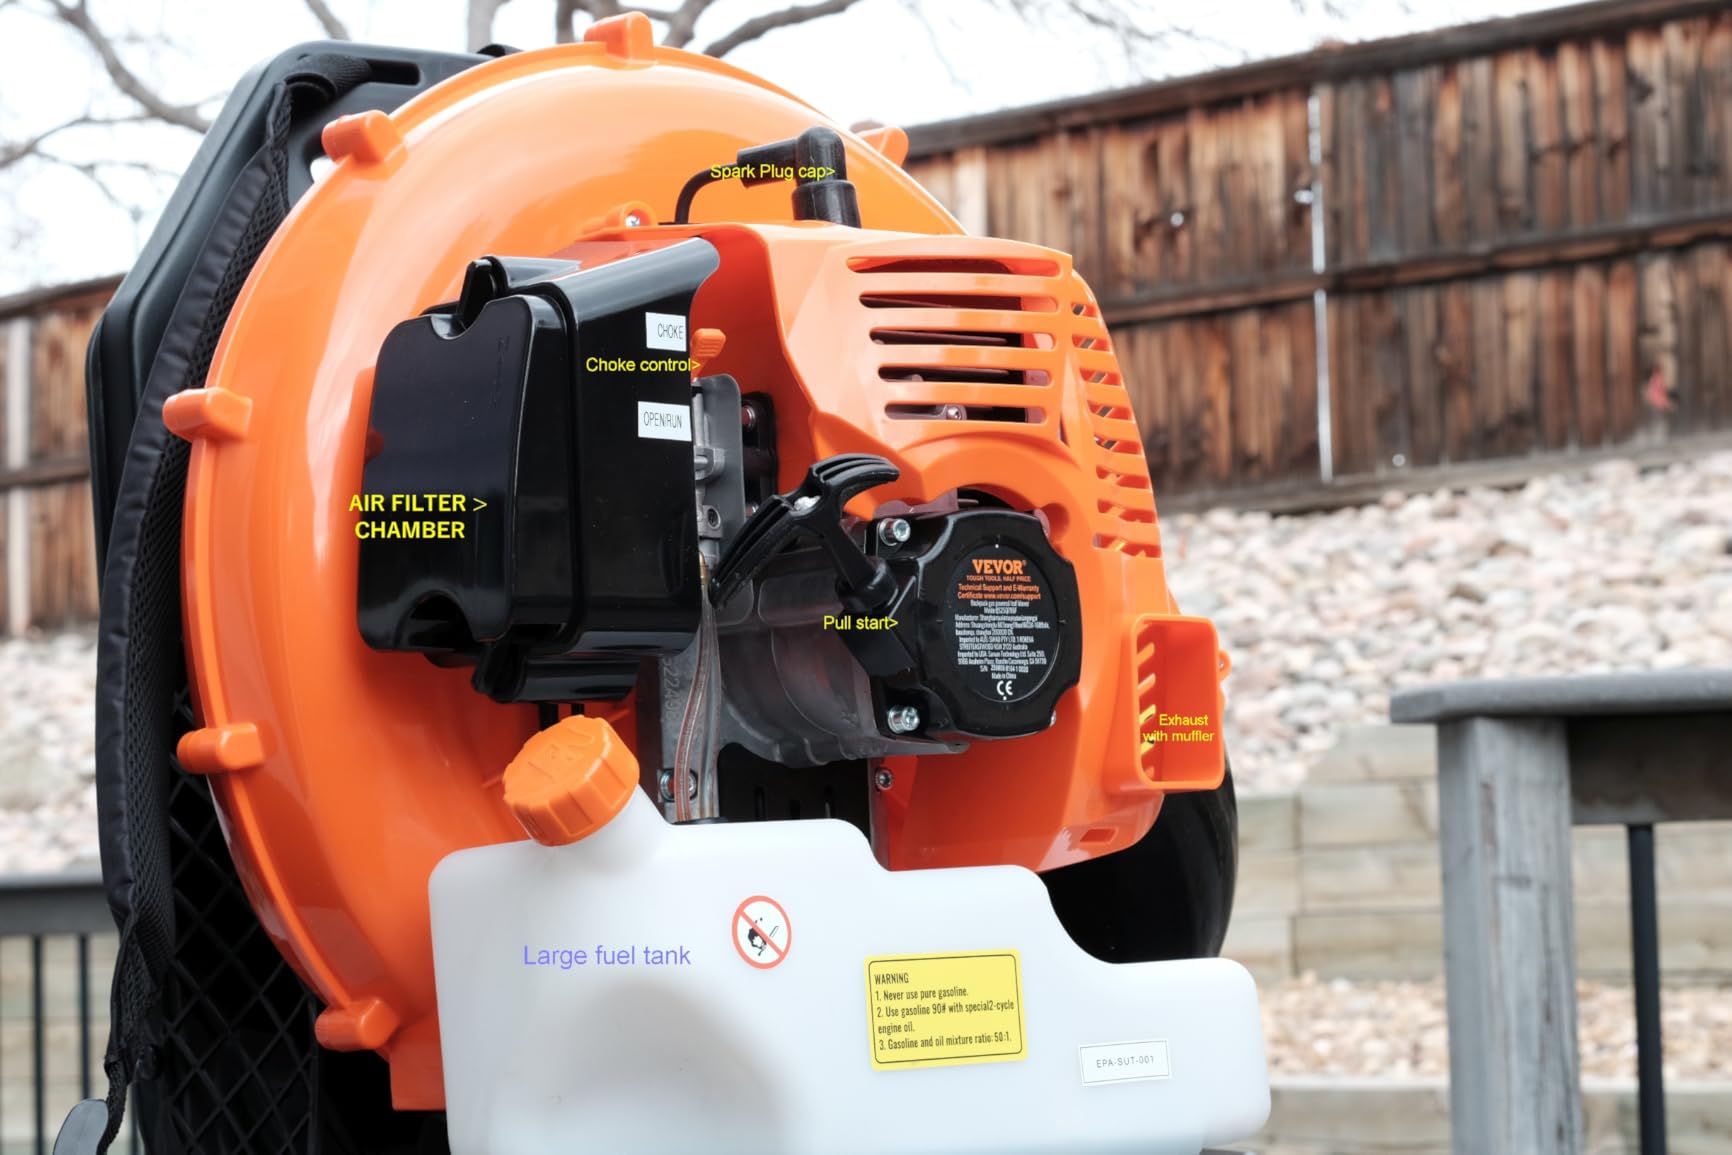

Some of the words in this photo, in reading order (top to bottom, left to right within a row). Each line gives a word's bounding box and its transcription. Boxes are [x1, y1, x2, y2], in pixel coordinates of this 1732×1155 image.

[658, 323, 684, 340] CHOKE
[644, 411, 682, 429] OPEN/RUN
[972, 560, 1023, 574] VEVOR
[874, 973, 909, 984] WARNING
[876, 991, 882, 1001] 1.
[884, 990, 904, 1000] Never
[906, 990, 918, 1000] use
[920, 989, 936, 1002] pure
[938, 986, 968, 1000] gasoline.
[877, 1006, 884, 1018] 2.
[886, 1006, 899, 1016] Use
[901, 1004, 930, 1018] gasoline
[932, 1003, 946, 1014] 90#
[948, 1002, 964, 1012] with
[878, 1024, 902, 1035] engine
[904, 1022, 915, 1032] oil.
[879, 1039, 886, 1050] 3.
[888, 1037, 918, 1050] Gasoline
[920, 1036, 934, 1048] and
[935, 1035, 944, 1046] oil
[946, 1034, 973, 1046] mixture
[974, 1032, 994, 1044] ratio:
[1096, 1056, 1154, 1068] EPA-SUT-001
